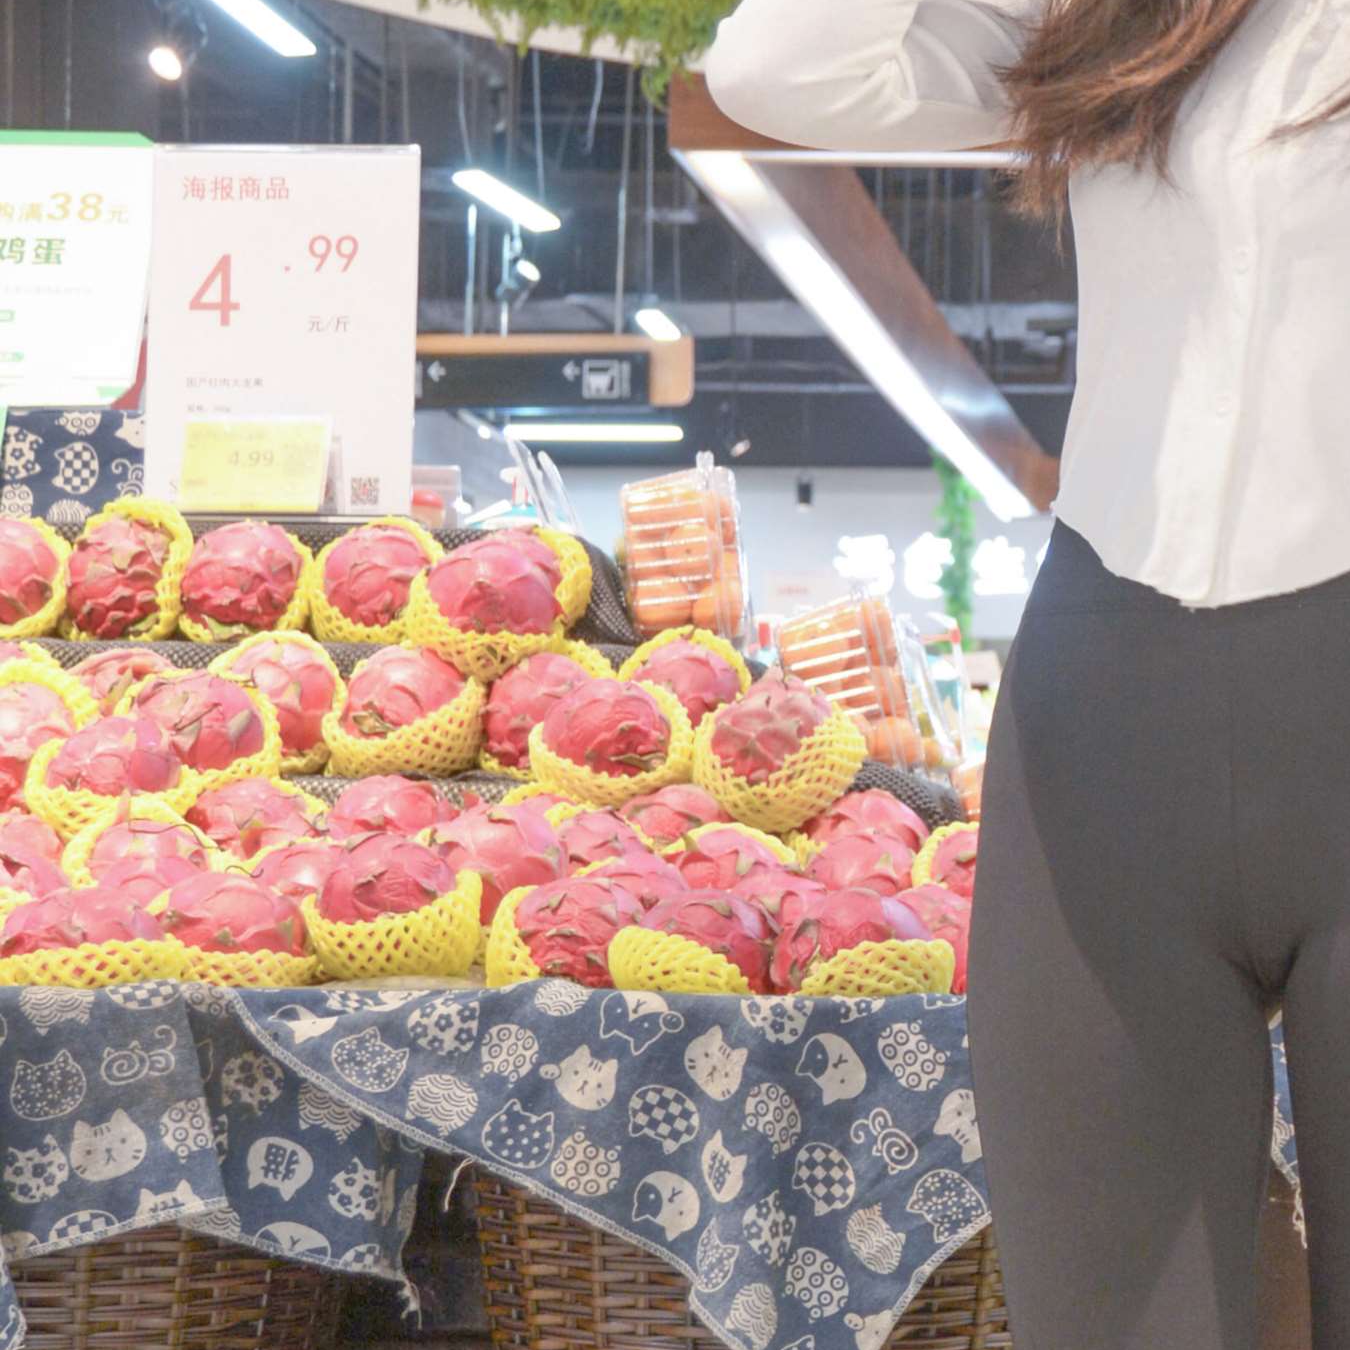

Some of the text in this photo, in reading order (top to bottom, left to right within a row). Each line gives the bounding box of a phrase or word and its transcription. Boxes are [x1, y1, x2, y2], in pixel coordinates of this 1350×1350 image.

[183, 175, 290, 201] 海报商品
[308, 314, 350, 333] 元/斤
